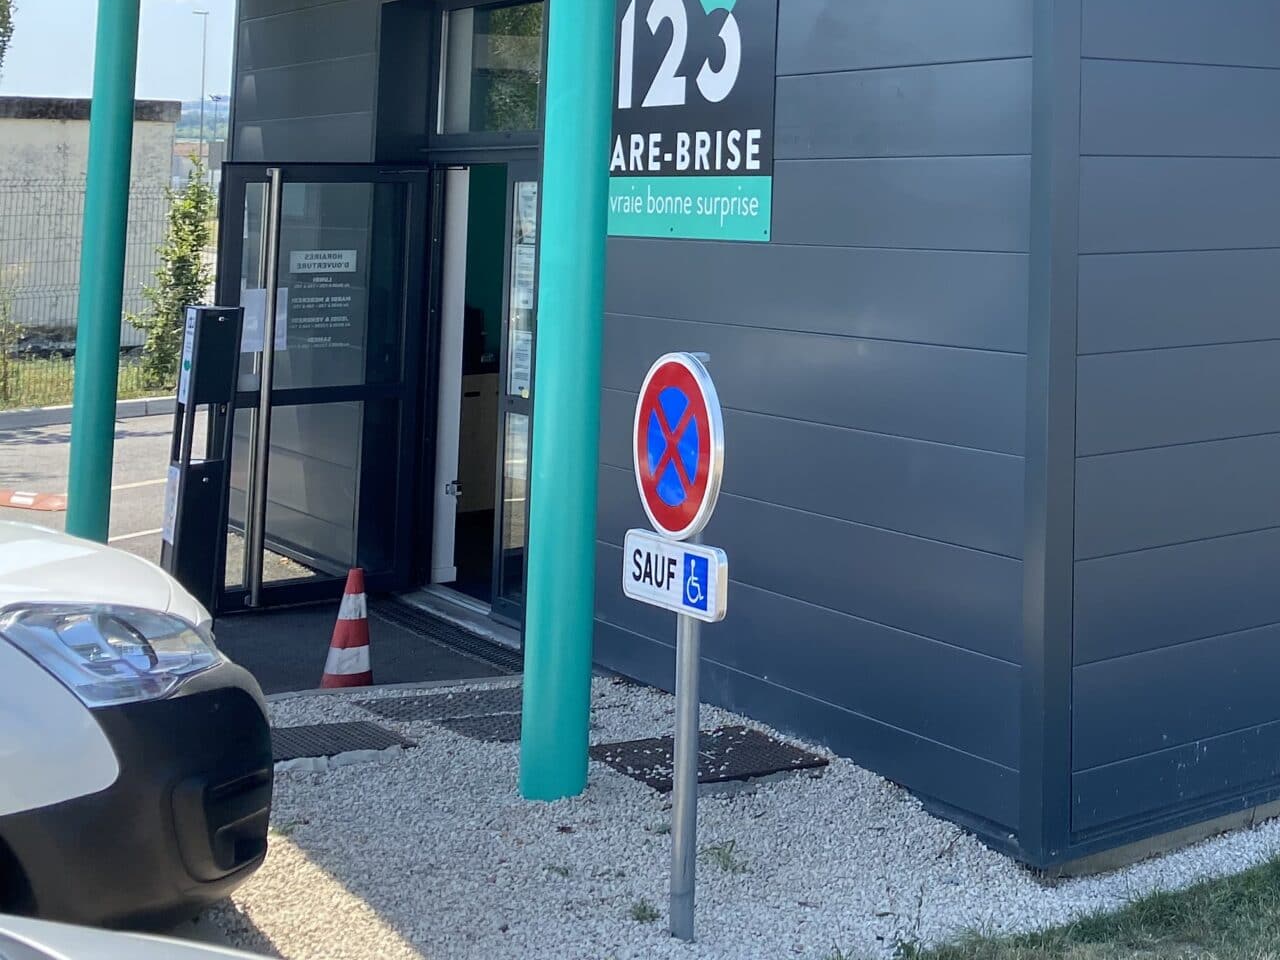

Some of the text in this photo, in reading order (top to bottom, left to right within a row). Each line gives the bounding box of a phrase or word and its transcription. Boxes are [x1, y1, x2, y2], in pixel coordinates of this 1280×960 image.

[610, 185, 759, 227] vraie bonne surprise
[632, 548, 677, 591] SAUF
